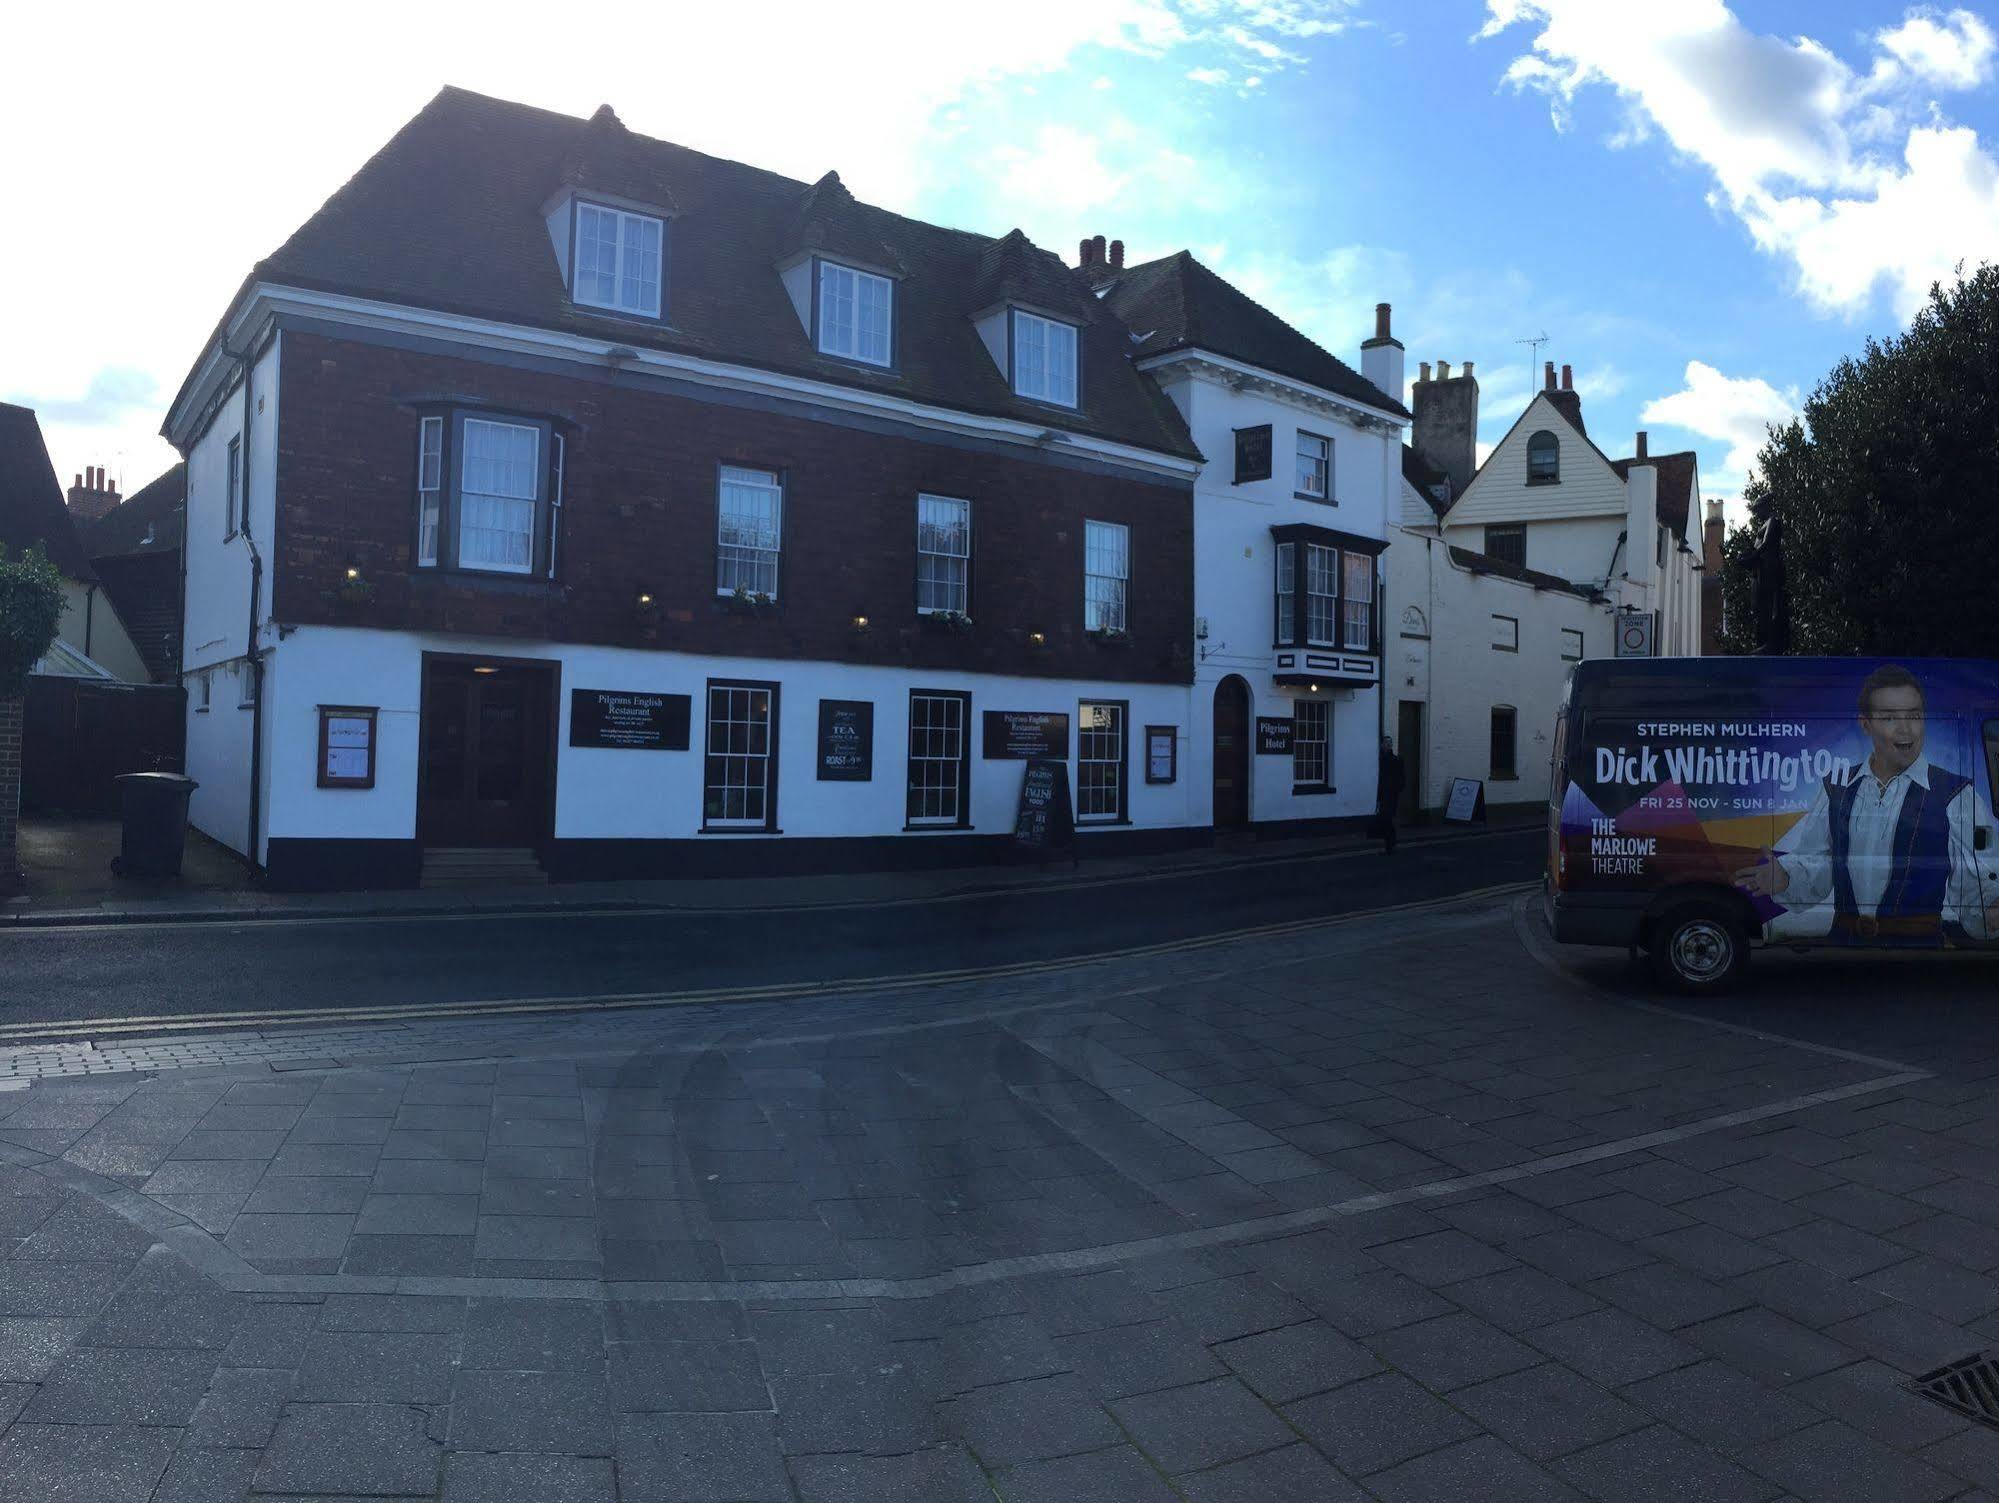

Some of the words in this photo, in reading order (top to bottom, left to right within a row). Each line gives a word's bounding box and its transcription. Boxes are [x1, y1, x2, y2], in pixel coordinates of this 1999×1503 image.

[598, 695, 632, 707] Pilgrims
[634, 696, 663, 707] English
[608, 706, 650, 716] Restaurant
[832, 726, 856, 735] TEA
[1260, 722, 1290, 735] Pilgrims
[1637, 723, 1716, 738] STEPHEN
[1721, 723, 1806, 738] MULHERN
[1265, 738, 1285, 749] Hotel
[1596, 745, 1661, 785] Dick
[1665, 746, 1850, 791] Whittington
[1029, 798, 1046, 806] FOOD
[1640, 797, 1662, 809] FRI
[1666, 797, 1684, 809] 25
[1687, 797, 1719, 809] NOV
[1732, 797, 1763, 809] SUN
[1779, 798, 1808, 810] JAN
[1591, 818, 1616, 836] THE
[1591, 838, 1656, 856] MARLOWE
[1592, 857, 1644, 875] THEATRE
